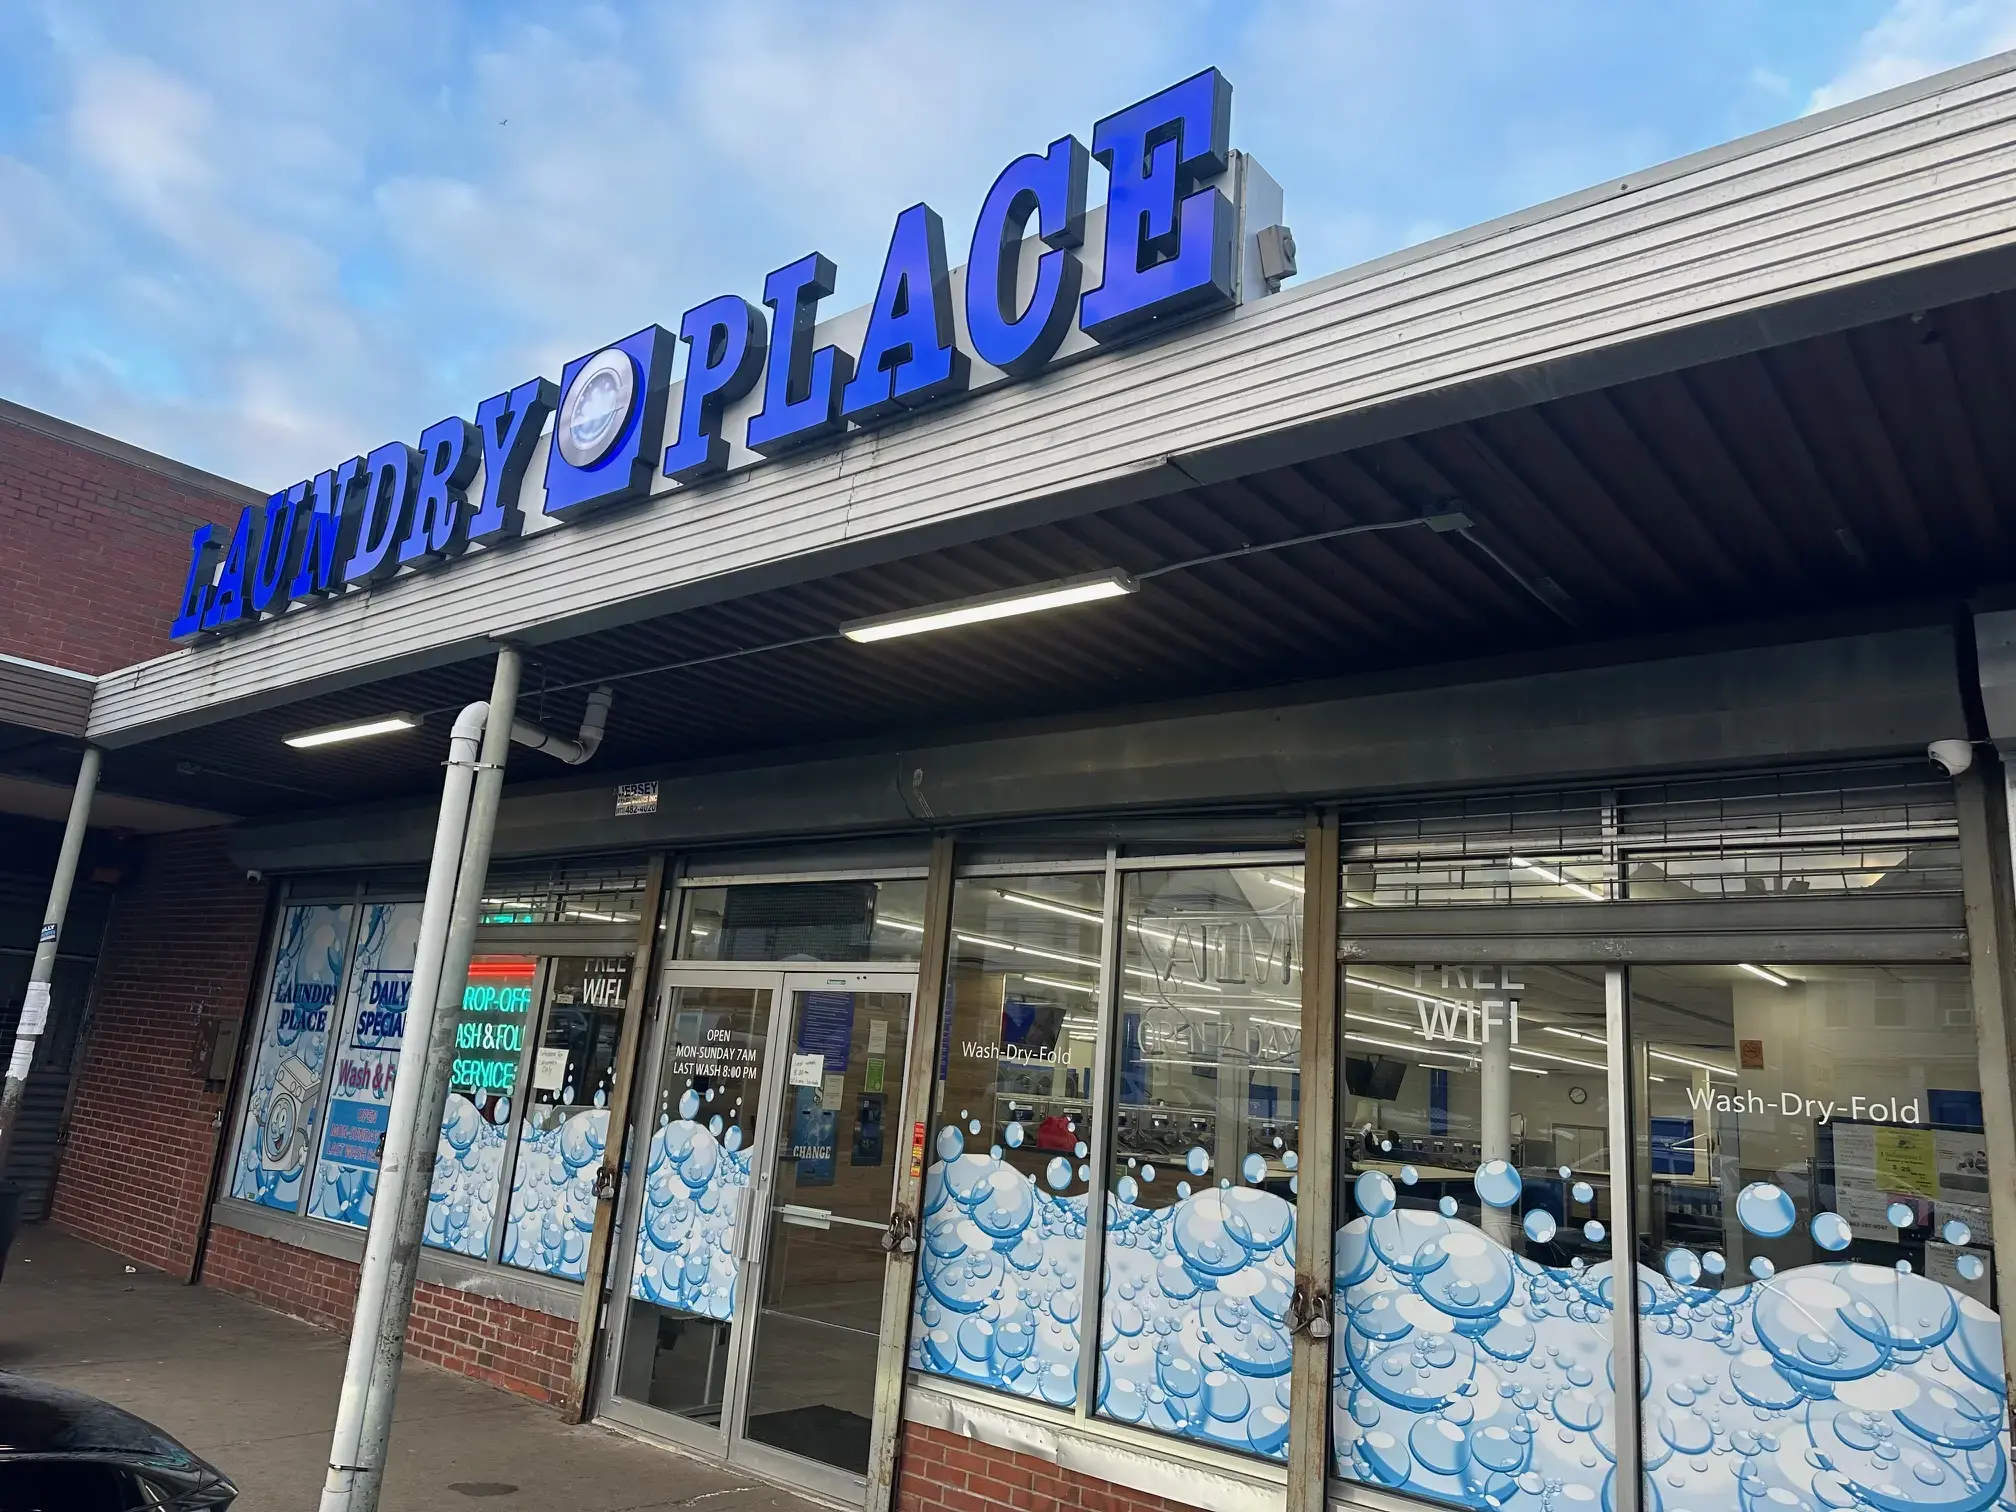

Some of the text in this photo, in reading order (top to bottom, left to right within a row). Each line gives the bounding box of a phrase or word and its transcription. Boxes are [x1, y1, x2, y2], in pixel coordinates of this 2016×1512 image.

[169, 66, 1233, 642] LAUNDRY PLACE
[618, 782, 658, 797] JERSEY
[368, 980, 412, 1007] DAILY
[462, 986, 532, 1013] ROP-OFF
[582, 978, 623, 1006] WIFI
[278, 1008, 329, 1033] PLACE
[1416, 999, 1520, 1045] WIFI
[454, 1022, 483, 1049] ASH
[483, 1022, 495, 1050] &
[706, 1029, 732, 1042] OPEN
[1245, 1023, 1302, 1064] DAY
[675, 1045, 757, 1062] MON-SUNDAY 7AM
[961, 1041, 1072, 1066] Wash-Dry-Fold
[338, 1058, 372, 1090] Wash
[372, 1062, 384, 1091] &
[451, 1058, 514, 1089] SERVICE
[673, 1061, 695, 1075] LAST
[695, 1063, 722, 1077] WASH
[742, 1066, 758, 1080] PM
[357, 1107, 378, 1124] OPEN
[1686, 1087, 1920, 1125] Wash-Dry-Fold
[793, 1145, 832, 1160] CHANGE
